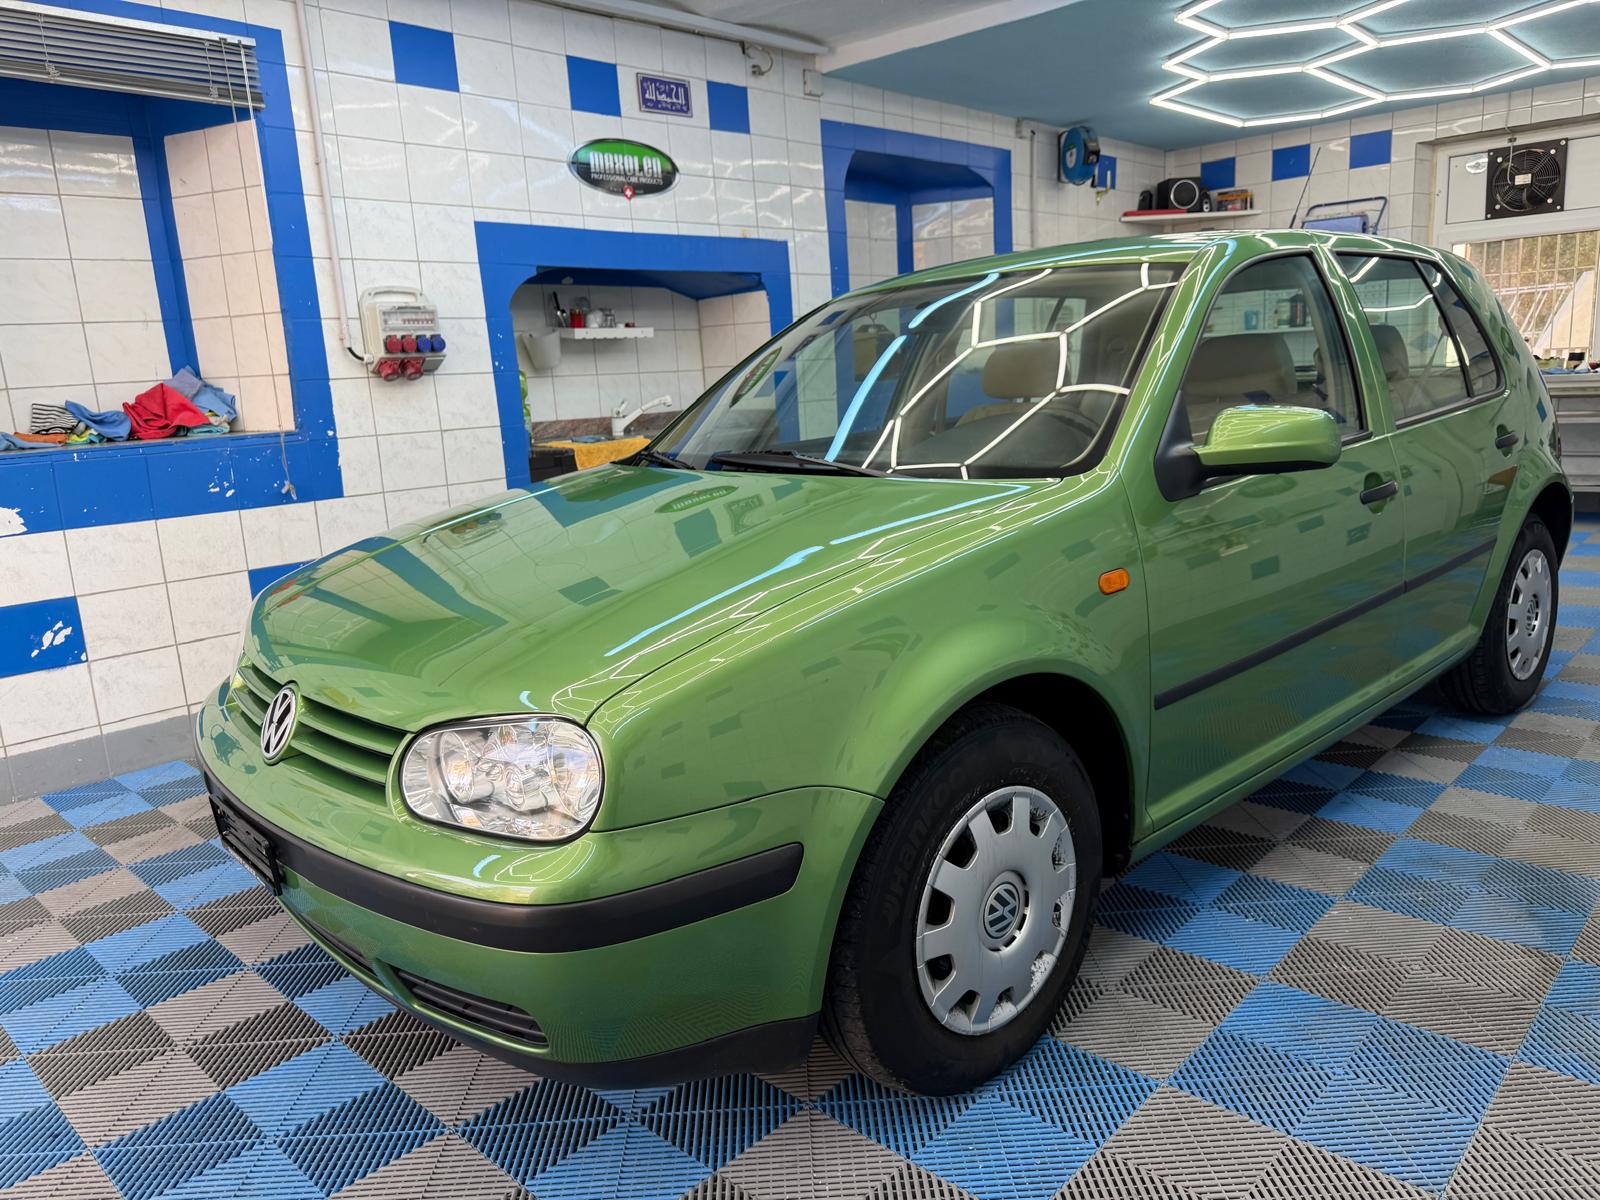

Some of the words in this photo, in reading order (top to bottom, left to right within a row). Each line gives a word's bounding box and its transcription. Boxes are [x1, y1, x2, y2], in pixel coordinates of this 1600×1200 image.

[591, 173, 626, 182] PROFESSIONAL
[627, 175, 639, 184] CARE
[640, 177, 664, 186] PRODUCTS
